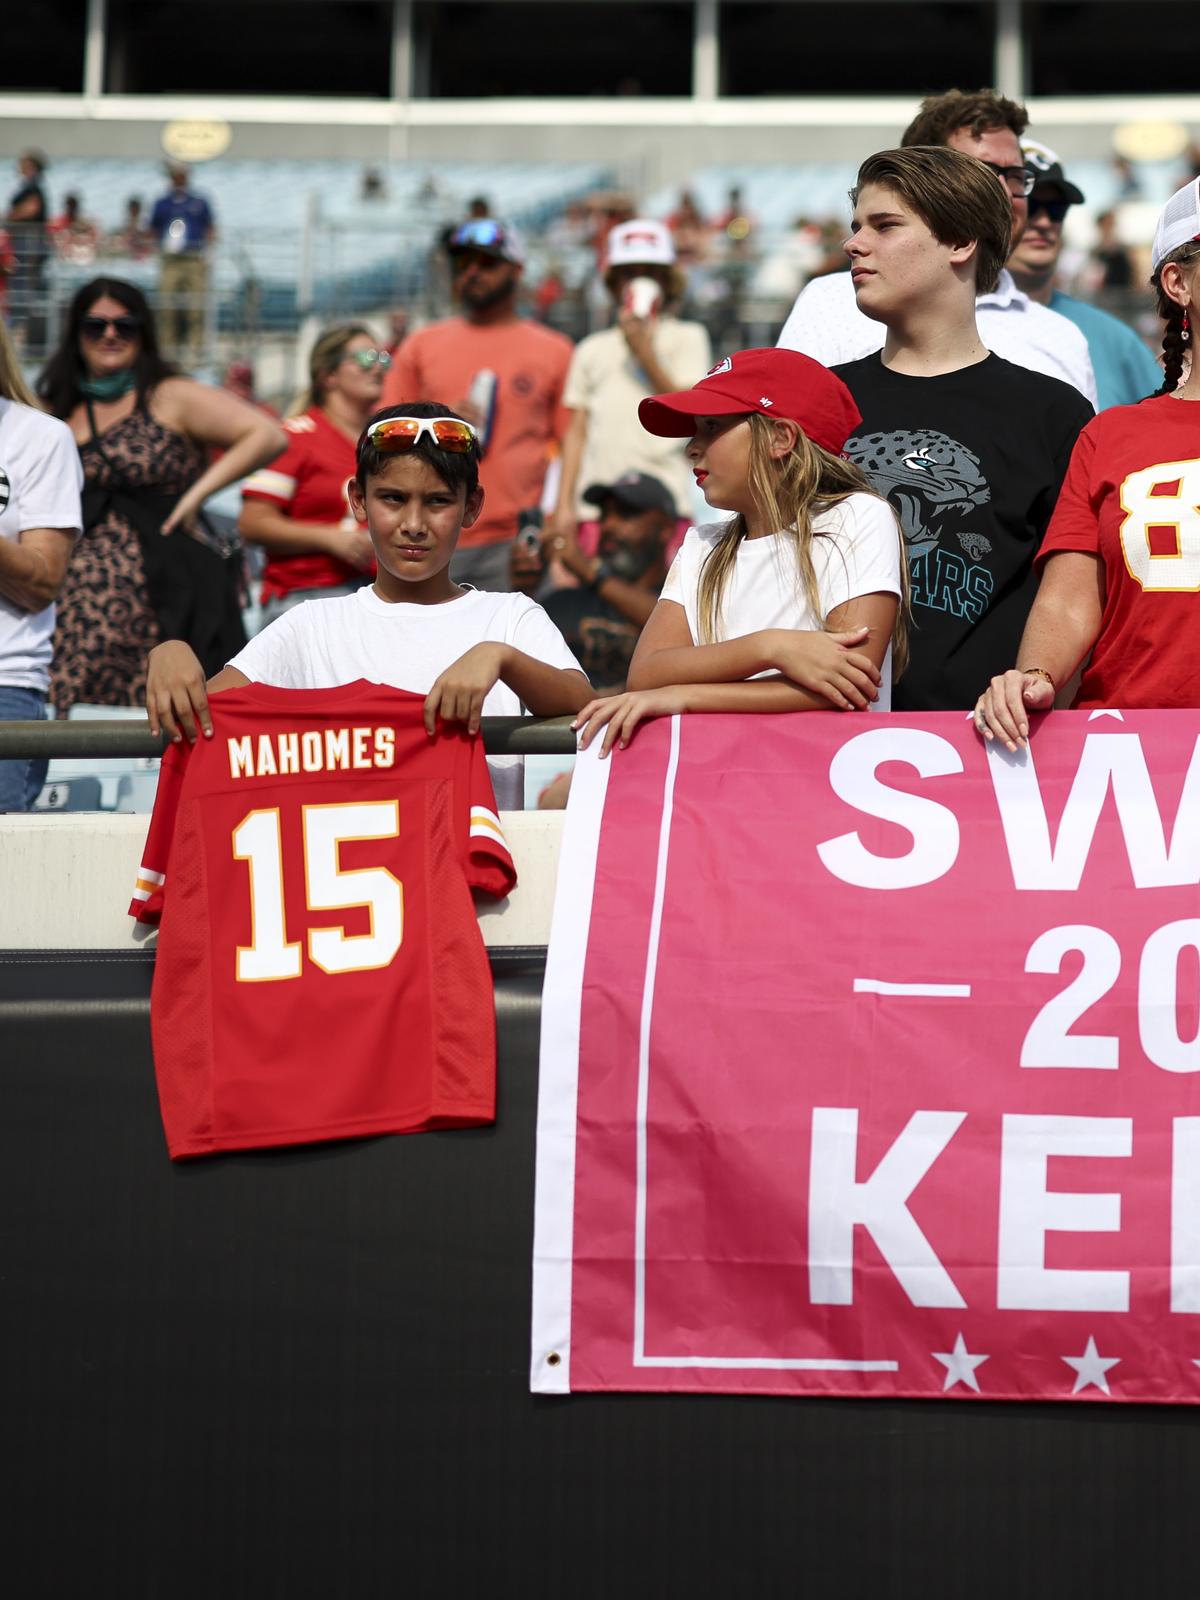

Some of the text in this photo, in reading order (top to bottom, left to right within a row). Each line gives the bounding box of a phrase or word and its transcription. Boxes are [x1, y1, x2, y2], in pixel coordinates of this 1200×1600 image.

[908, 546, 995, 625] ARS
[227, 727, 396, 779] MAHOMES
[231, 799, 404, 983] 15
